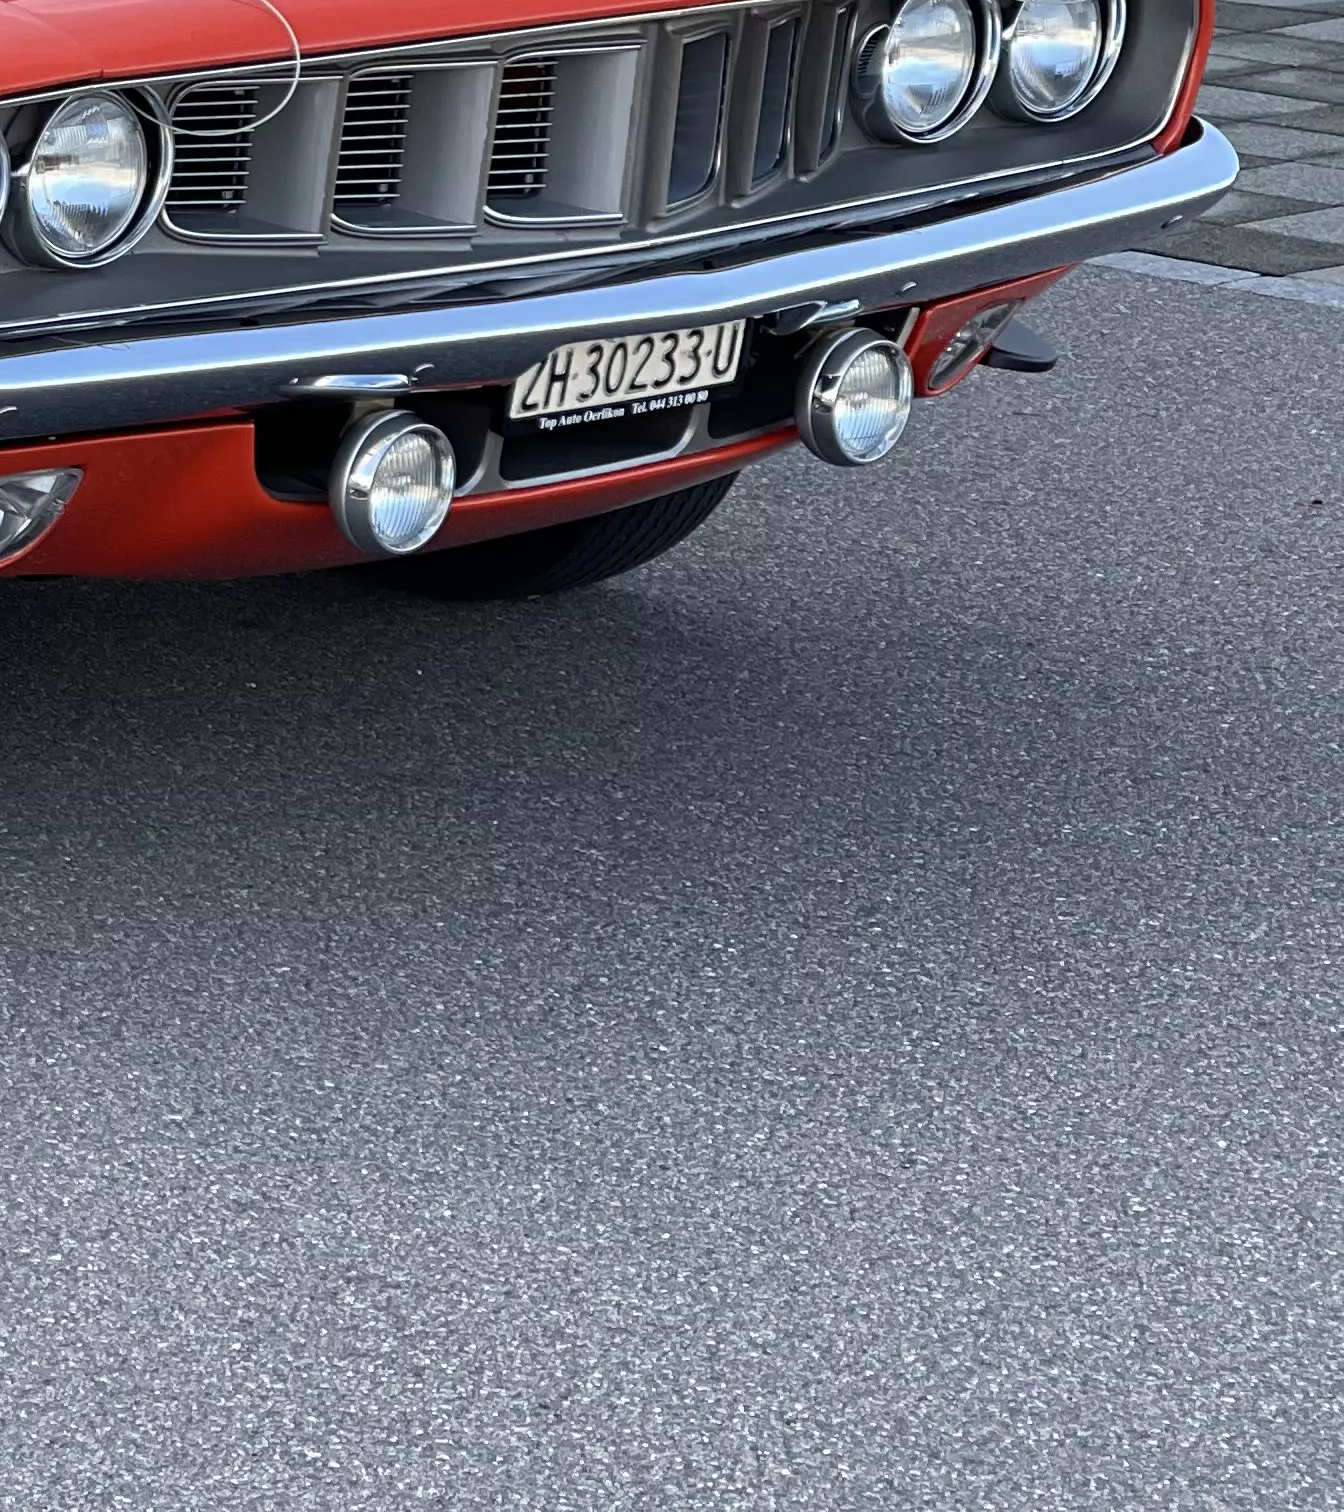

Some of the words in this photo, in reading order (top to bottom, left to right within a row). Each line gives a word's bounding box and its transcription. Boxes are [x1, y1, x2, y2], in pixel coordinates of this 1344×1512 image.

[539, 416, 558, 431] Top
[558, 413, 583, 427] Auto
[649, 396, 667, 411] 044
[667, 394, 684, 409] 313
